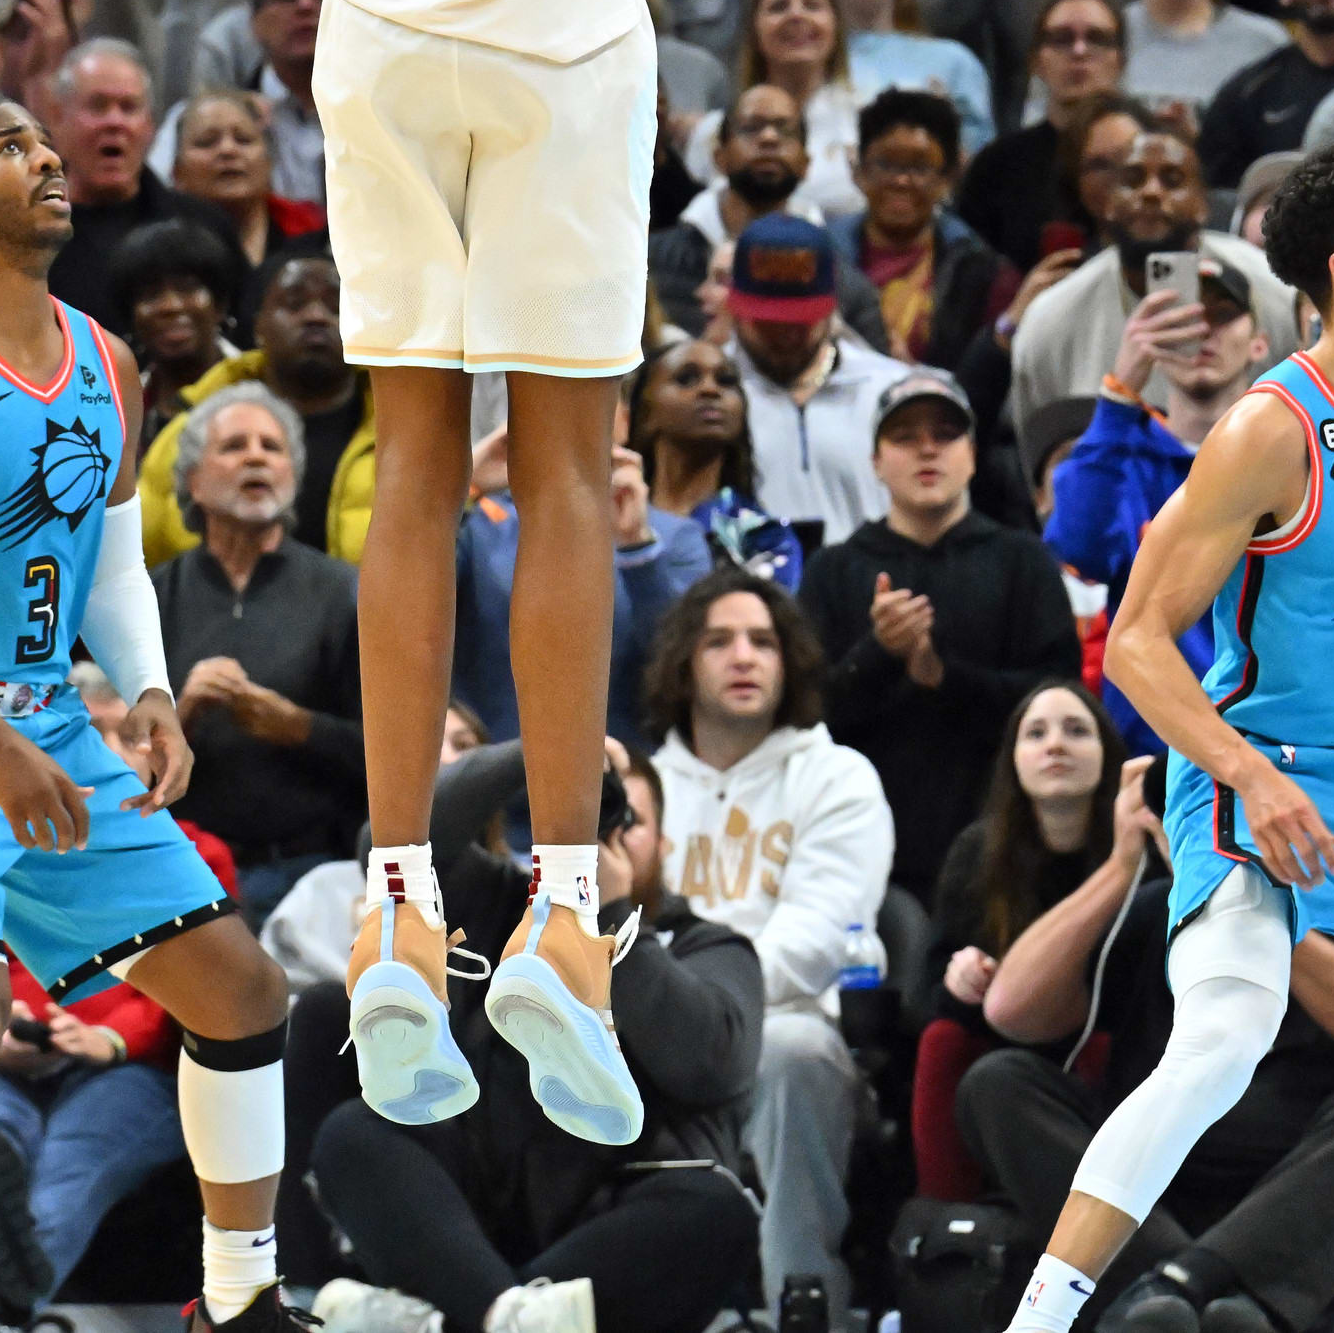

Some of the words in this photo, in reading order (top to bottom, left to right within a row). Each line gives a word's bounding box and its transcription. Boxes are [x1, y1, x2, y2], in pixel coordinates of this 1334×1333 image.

[80, 392, 112, 405] PayPal
[14, 554, 61, 665] 3
[660, 816, 794, 909] AVS
